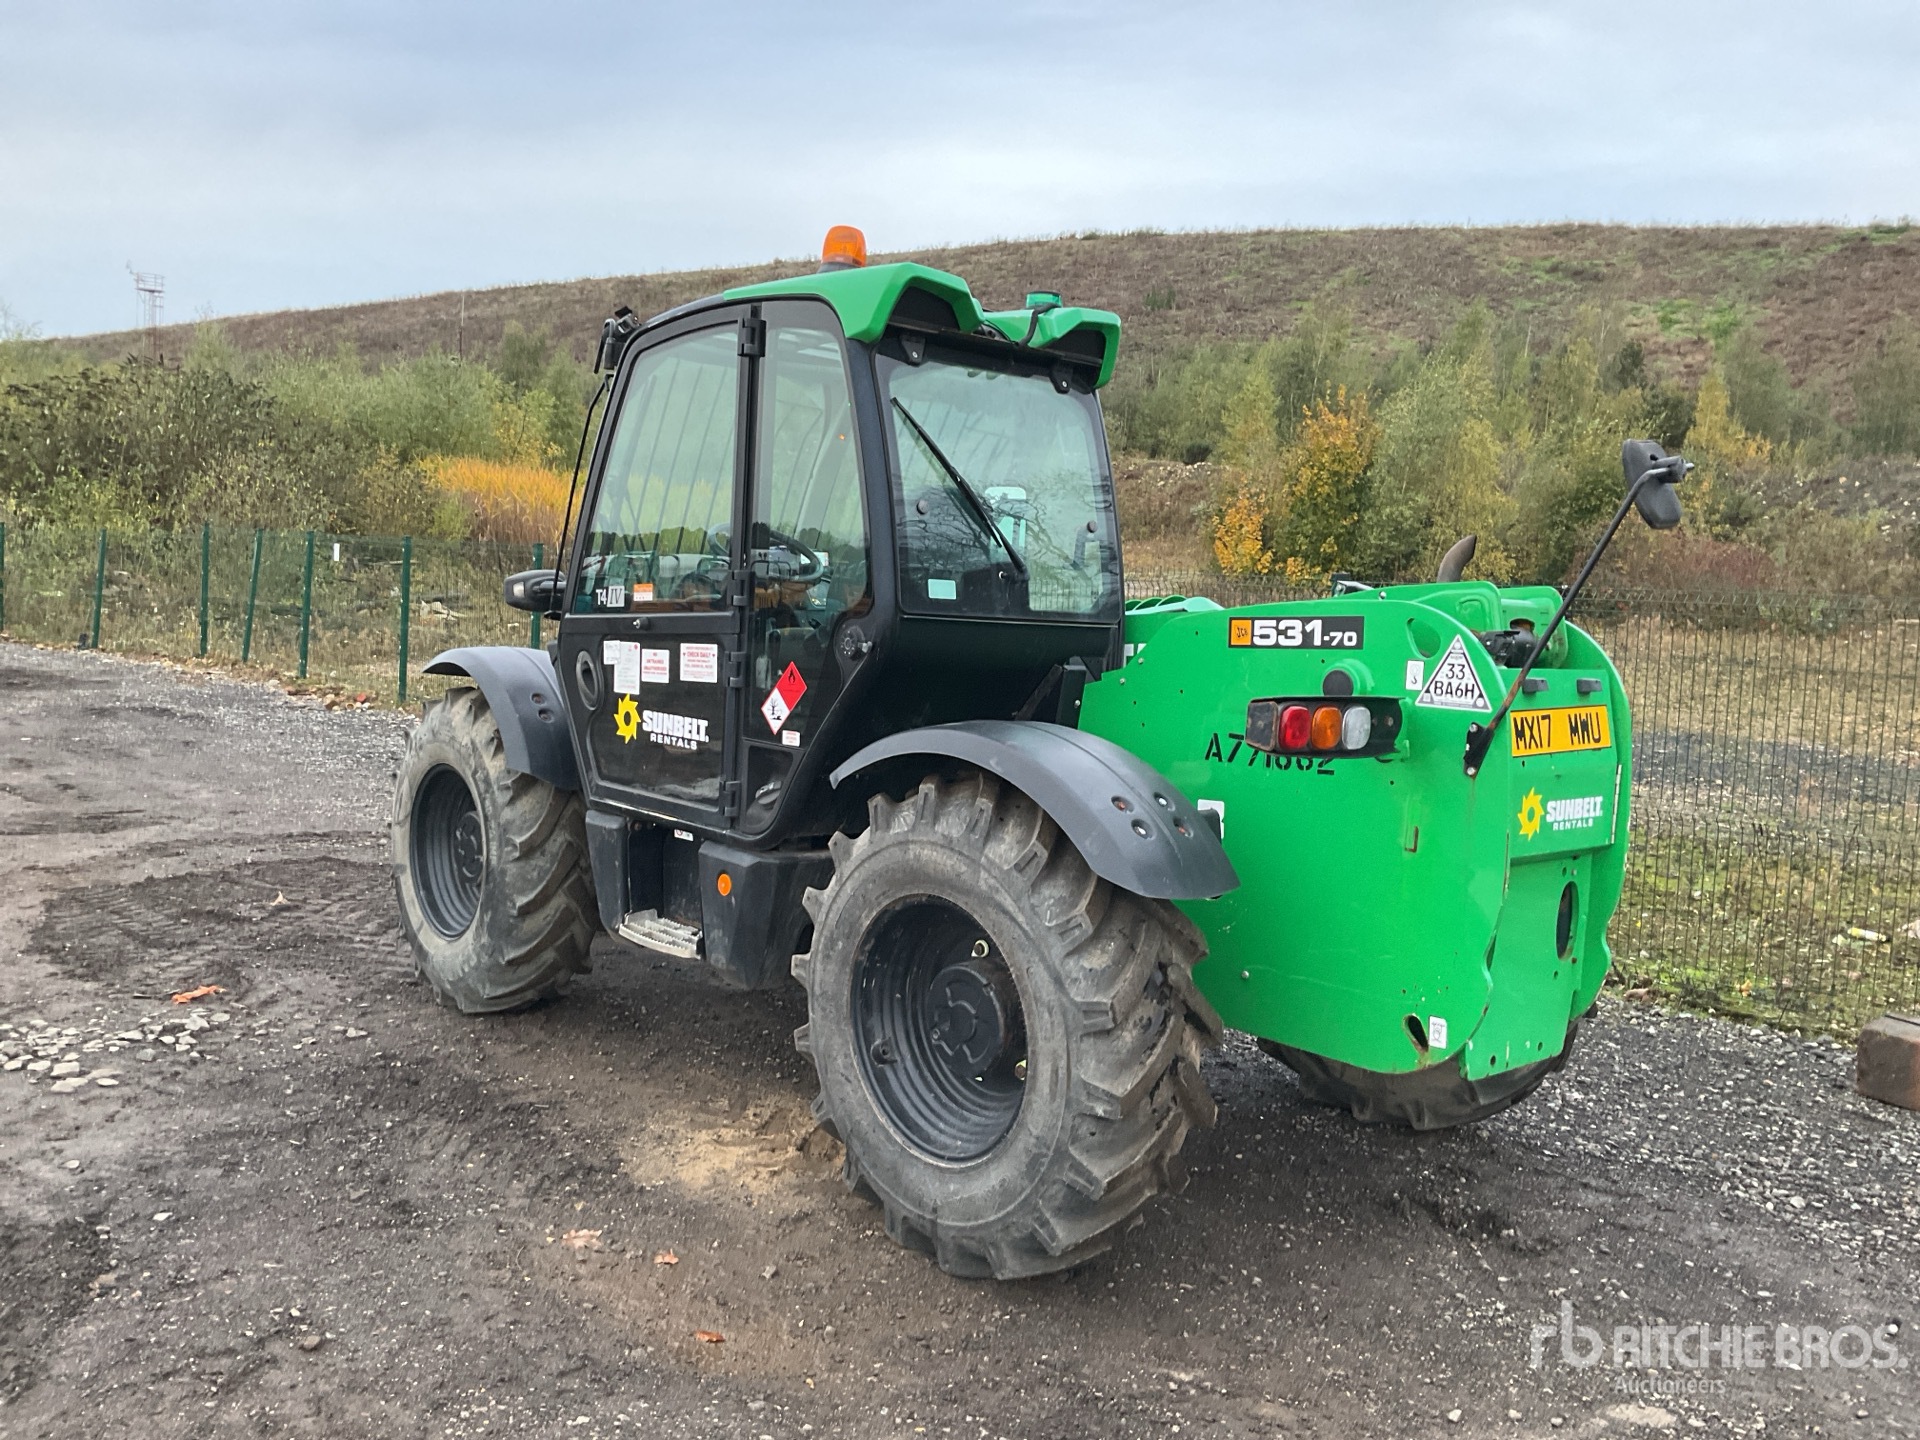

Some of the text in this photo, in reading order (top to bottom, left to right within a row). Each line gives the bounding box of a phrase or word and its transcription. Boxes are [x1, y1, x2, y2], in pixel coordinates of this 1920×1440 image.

[1252, 619, 1358, 646] 531-70
[1445, 663, 1466, 680] 33
[642, 709, 709, 742] SUNBELT
[1513, 711, 1602, 751] MX17 MWU
[650, 733, 698, 751] RENTALS
[1545, 796, 1603, 822] SUNBELT
[1552, 818, 1594, 831] RENTALS
